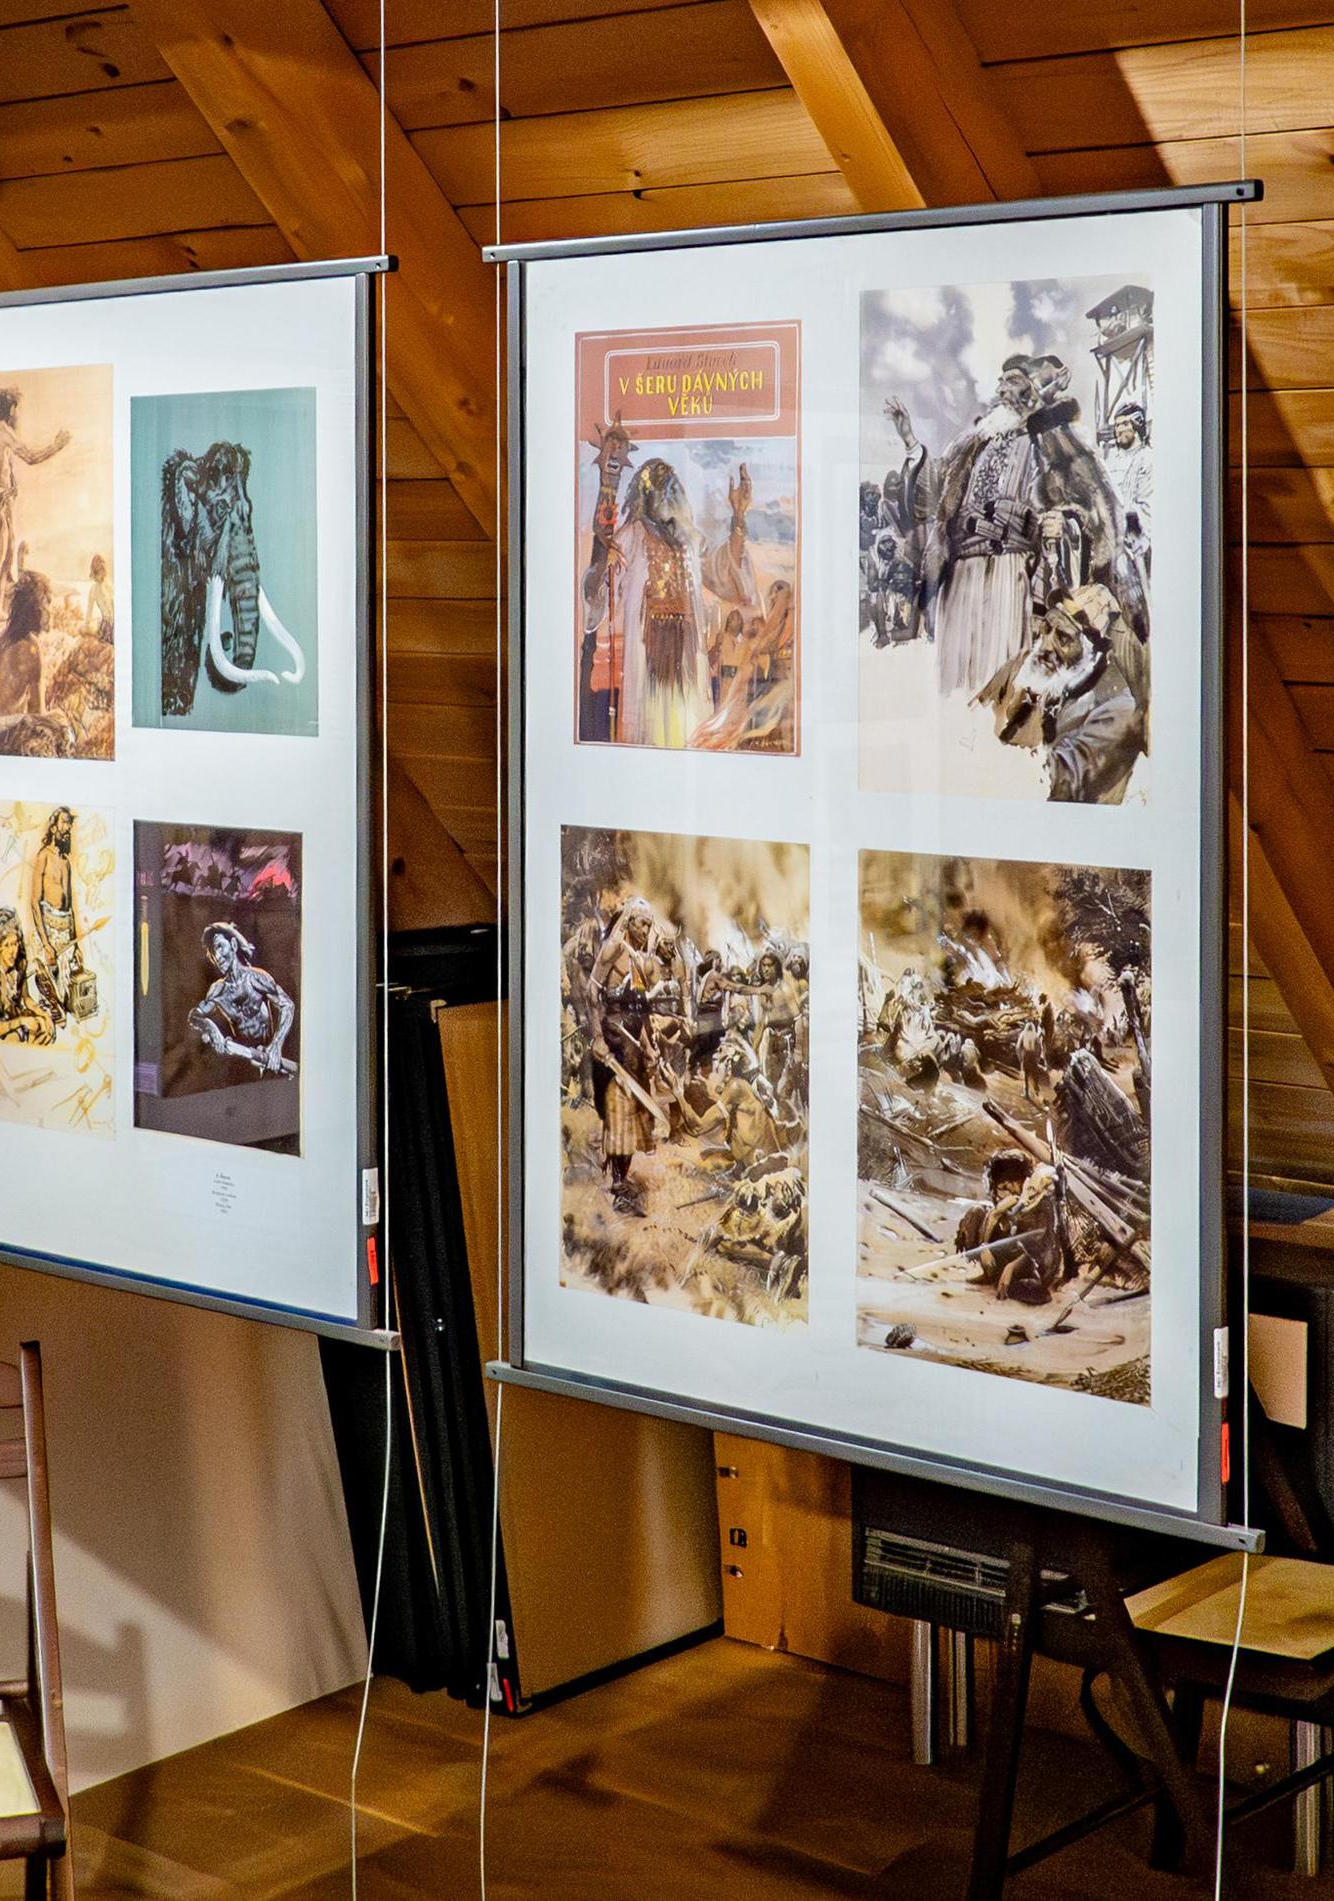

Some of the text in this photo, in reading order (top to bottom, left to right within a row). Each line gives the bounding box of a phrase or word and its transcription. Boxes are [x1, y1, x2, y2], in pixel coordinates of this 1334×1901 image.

[619, 367, 764, 396] V ŠERU DÁVNÝCH
[667, 392, 713, 417] VĚKŮ
